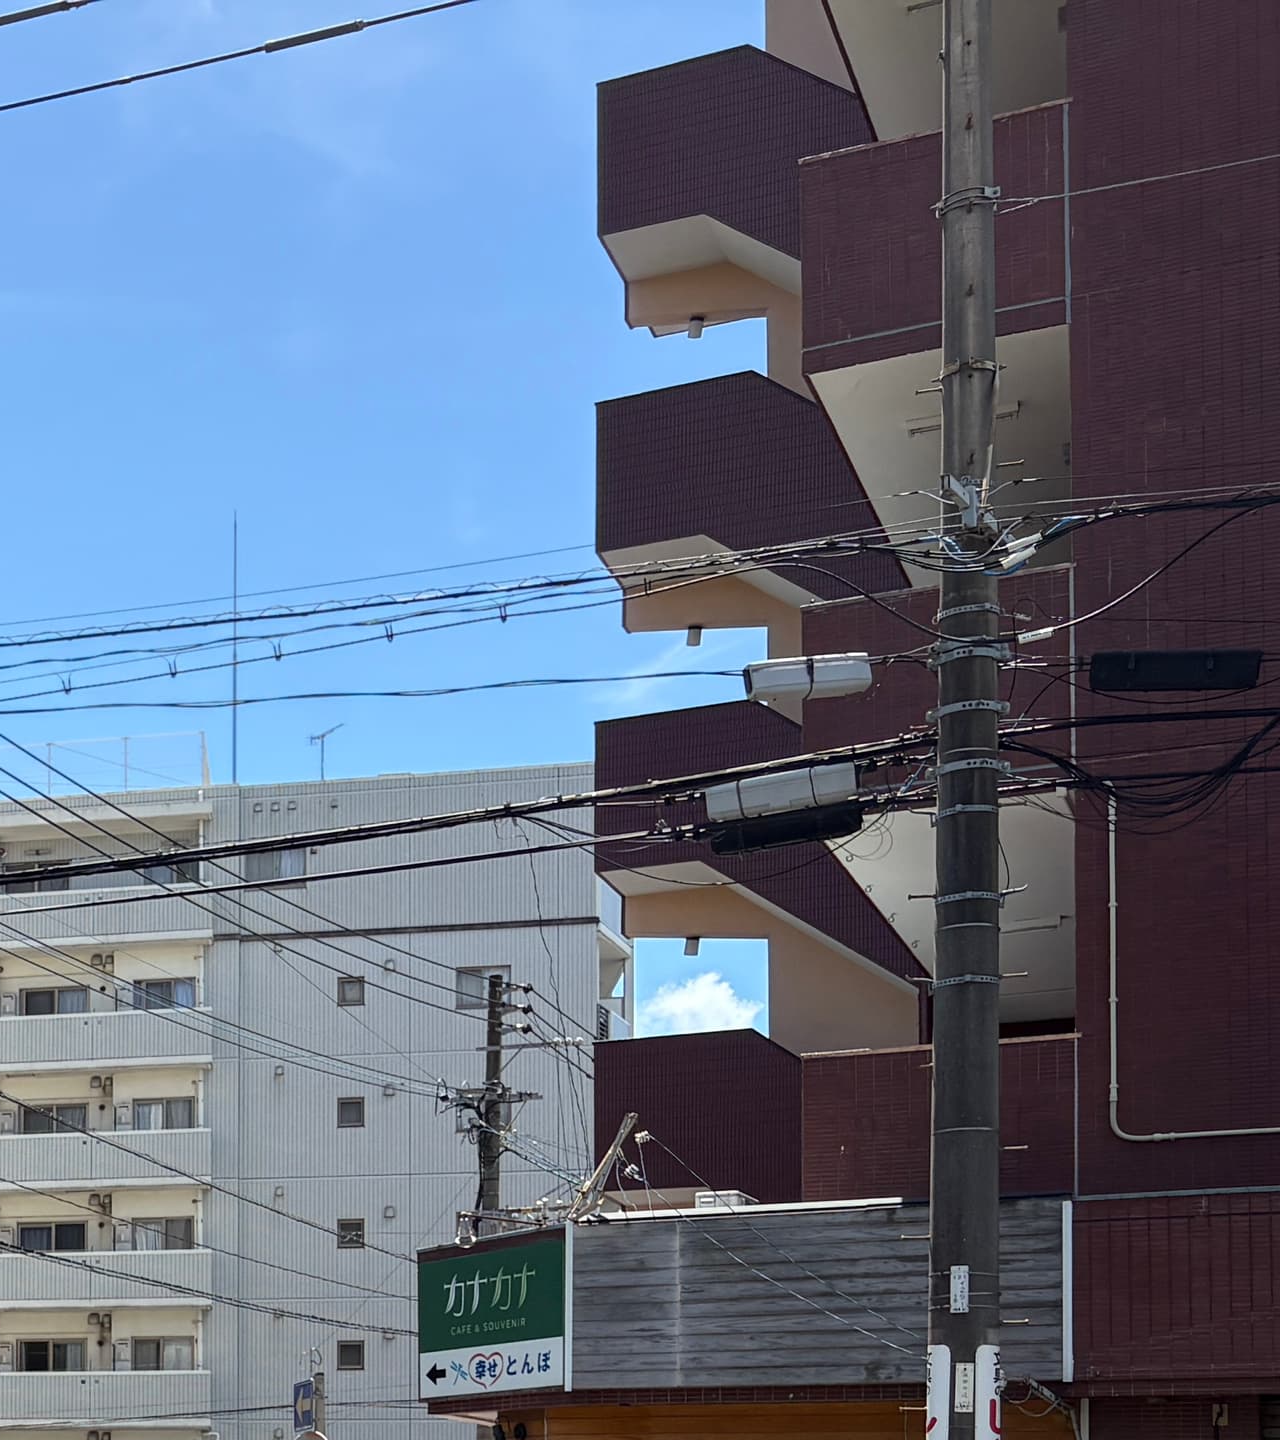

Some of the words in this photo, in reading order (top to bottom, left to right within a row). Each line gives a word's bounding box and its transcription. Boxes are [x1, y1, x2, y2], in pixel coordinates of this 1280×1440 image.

[443, 1262, 536, 1317] カナカナ
[450, 1322, 472, 1336] CAFE
[483, 1317, 526, 1332] SOUVENIR
